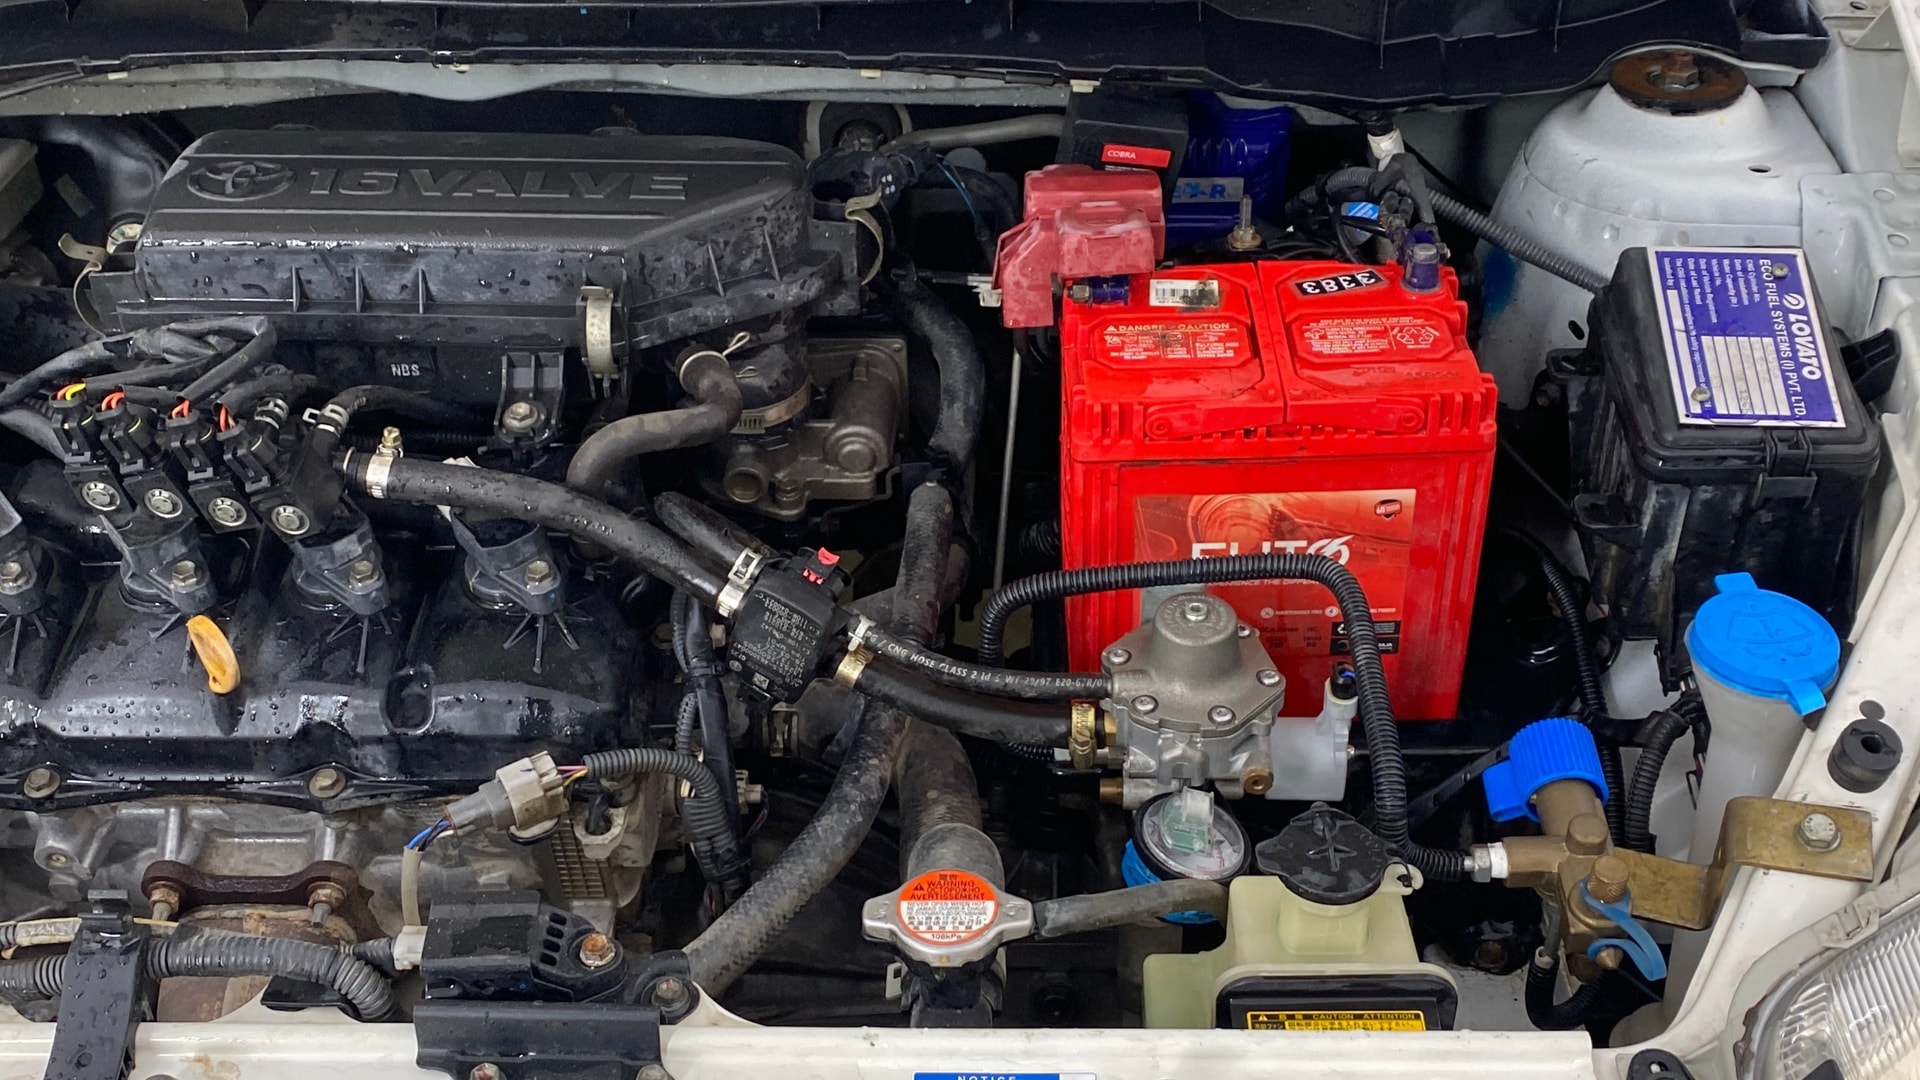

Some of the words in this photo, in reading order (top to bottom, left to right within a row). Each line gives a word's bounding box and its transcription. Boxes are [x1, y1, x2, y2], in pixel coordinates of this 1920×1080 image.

[1107, 150, 1136, 159] COBRA
[1663, 257, 1673, 278] Installed
[1676, 266, 1685, 278] CNG
[1710, 258, 1720, 276] Vehicle
[1722, 258, 1730, 273] Water
[1746, 259, 1754, 271] CNG
[1758, 259, 1773, 280] ECO
[1302, 273, 1376, 294] 3383
[1690, 276, 1699, 287] Last
[1702, 275, 1711, 292] Vehicle
[1725, 273, 1735, 295] Capacity
[1733, 258, 1741, 270] Date
[1738, 277, 1749, 305] Installation
[1747, 271, 1758, 292] Cylinder
[1764, 282, 1780, 308] FUEL
[1705, 293, 1717, 323] Registration
[1177, 323, 1230, 331] CAUTION
[1770, 310, 1792, 357] SYSTEMS
[1788, 313, 1821, 379] LOVATO
[390, 363, 420, 376] NBS
[1779, 359, 1795, 369] (I)
[1784, 372, 1800, 393] PVT.
[1791, 396, 1806, 417] LTD.
[888, 643, 908, 658] CNG
[910, 653, 936, 669] HOSE
[939, 663, 968, 678] CLASS
[970, 670, 978, 680] 2
